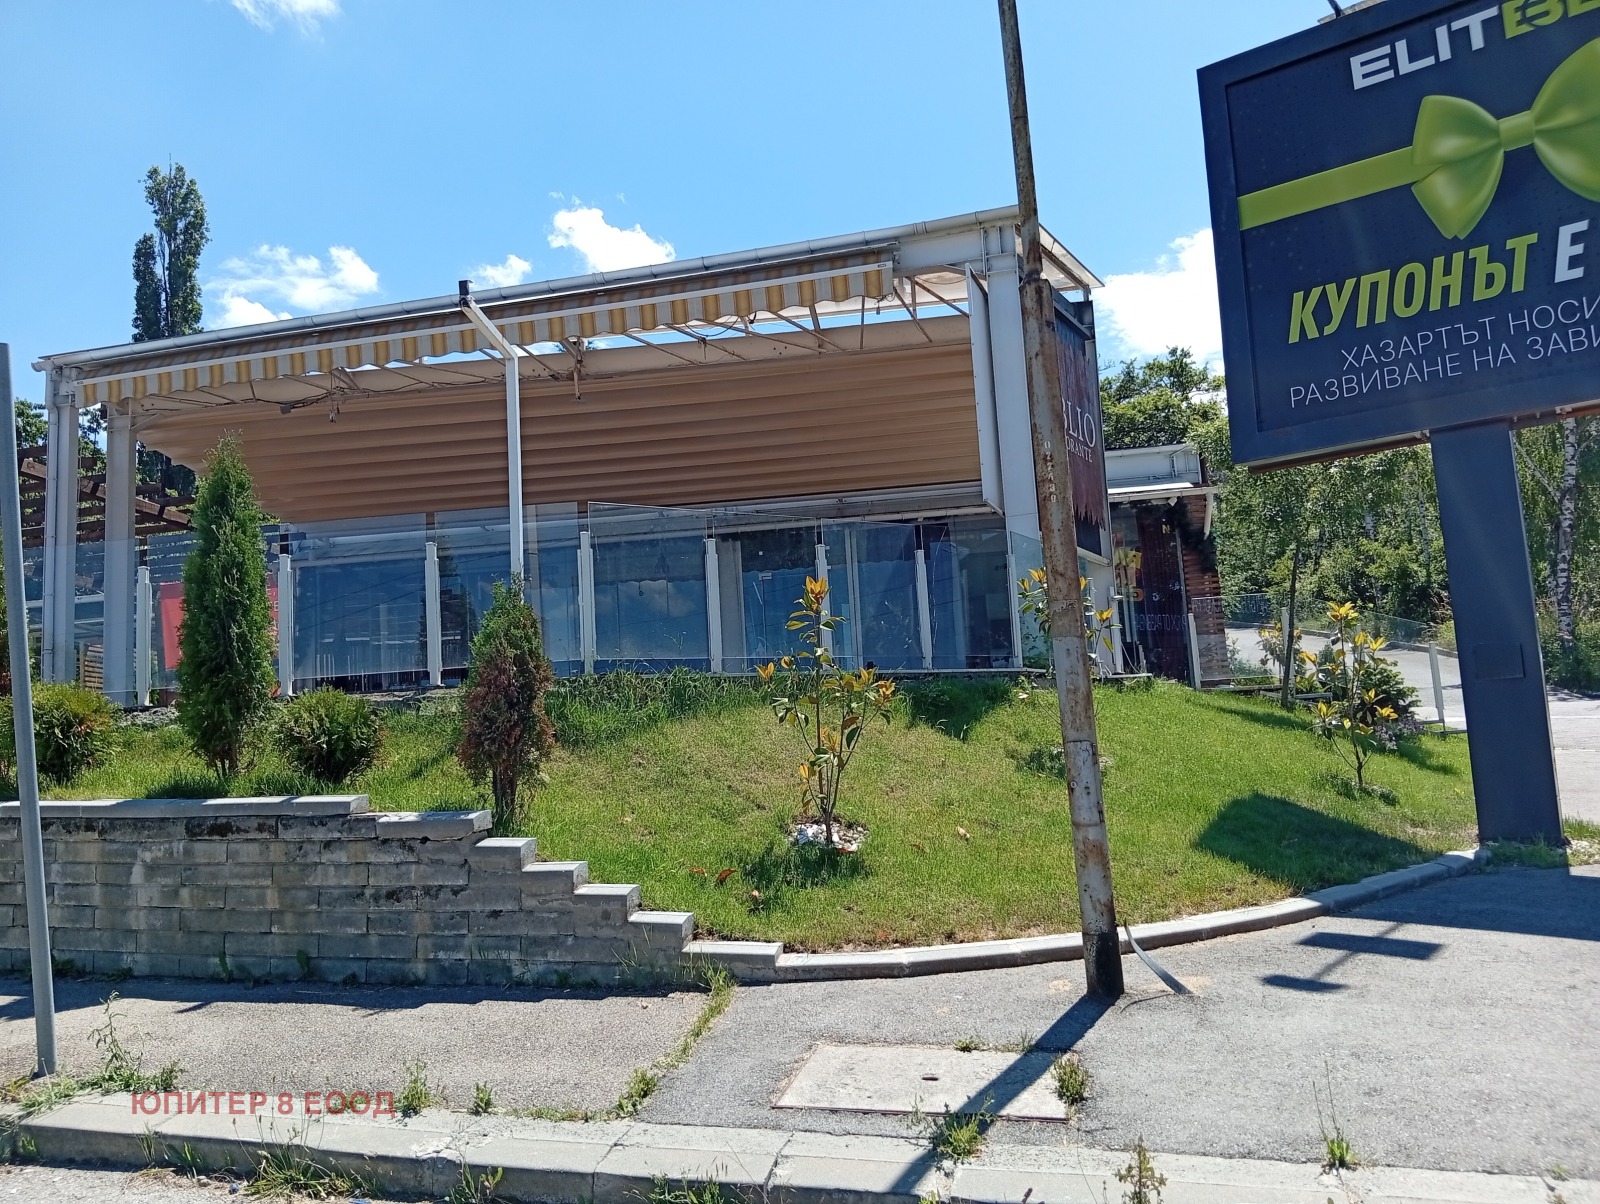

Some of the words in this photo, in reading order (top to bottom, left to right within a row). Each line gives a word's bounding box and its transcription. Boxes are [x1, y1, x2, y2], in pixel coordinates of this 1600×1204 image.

[1288, 232, 1538, 344] КУПОНЪТ
[1290, 350, 1462, 408] РАЗВИВАНЕ
[1473, 343, 1516, 372] НА
[1341, 316, 1496, 371] ХАЗАРТЪТ
